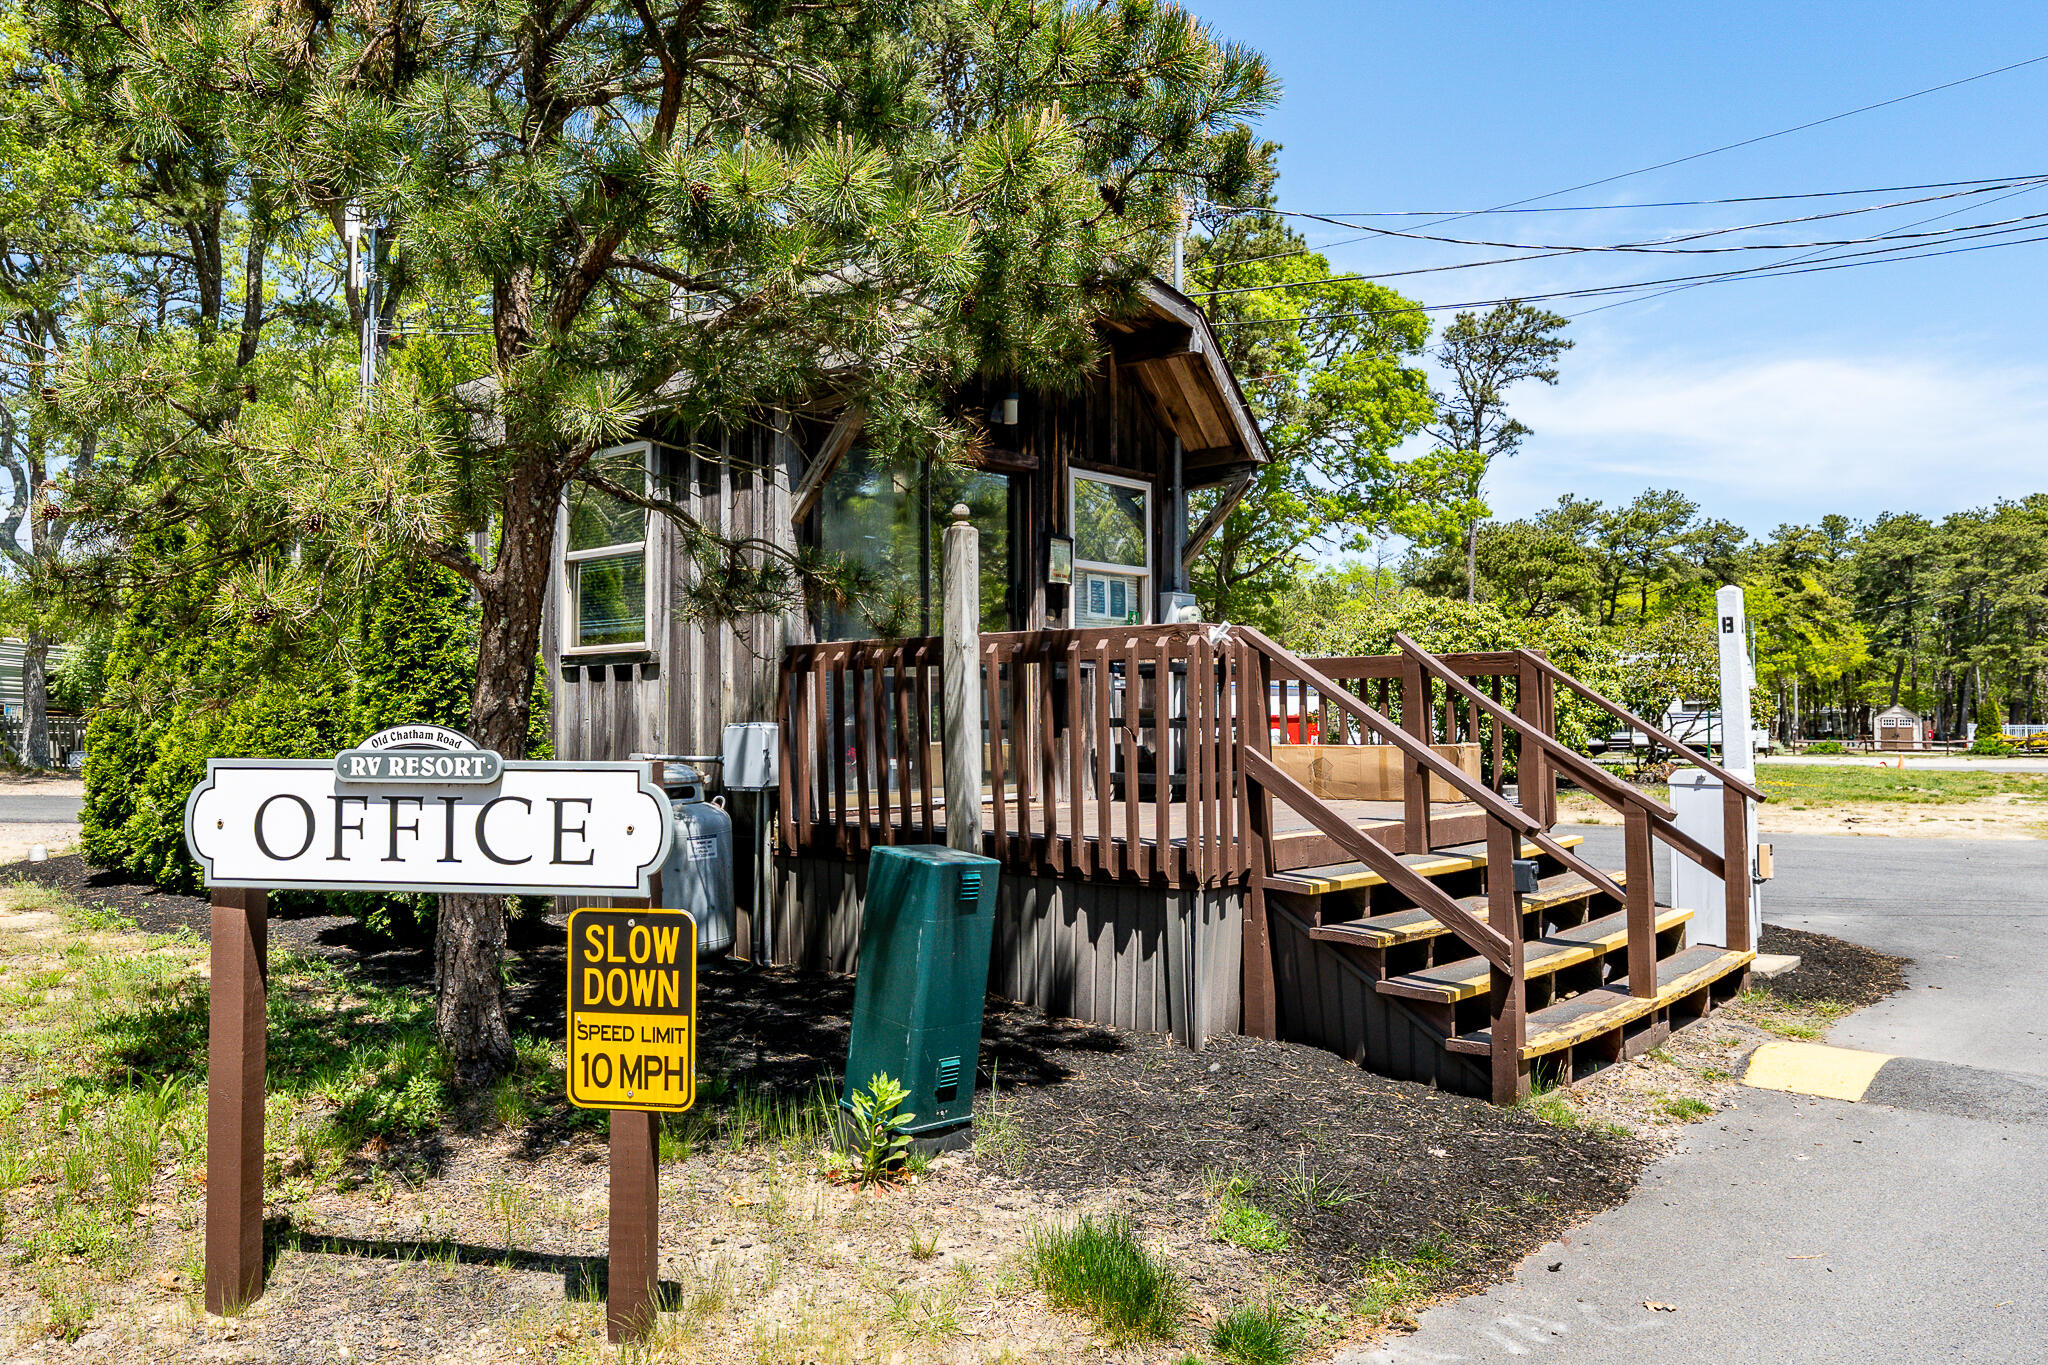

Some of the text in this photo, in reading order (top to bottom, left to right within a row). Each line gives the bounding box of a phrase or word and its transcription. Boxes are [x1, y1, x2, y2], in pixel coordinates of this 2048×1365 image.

[371, 729, 463, 749] Old Chatham Road
[350, 757, 486, 777] RV RESORT
[254, 794, 595, 866] OFFICE
[583, 924, 680, 964] SLOW
[583, 967, 679, 1008] DOWN
[577, 1024, 685, 1044] SPEED LIMIT
[581, 1052, 684, 1091] 10 MPH
